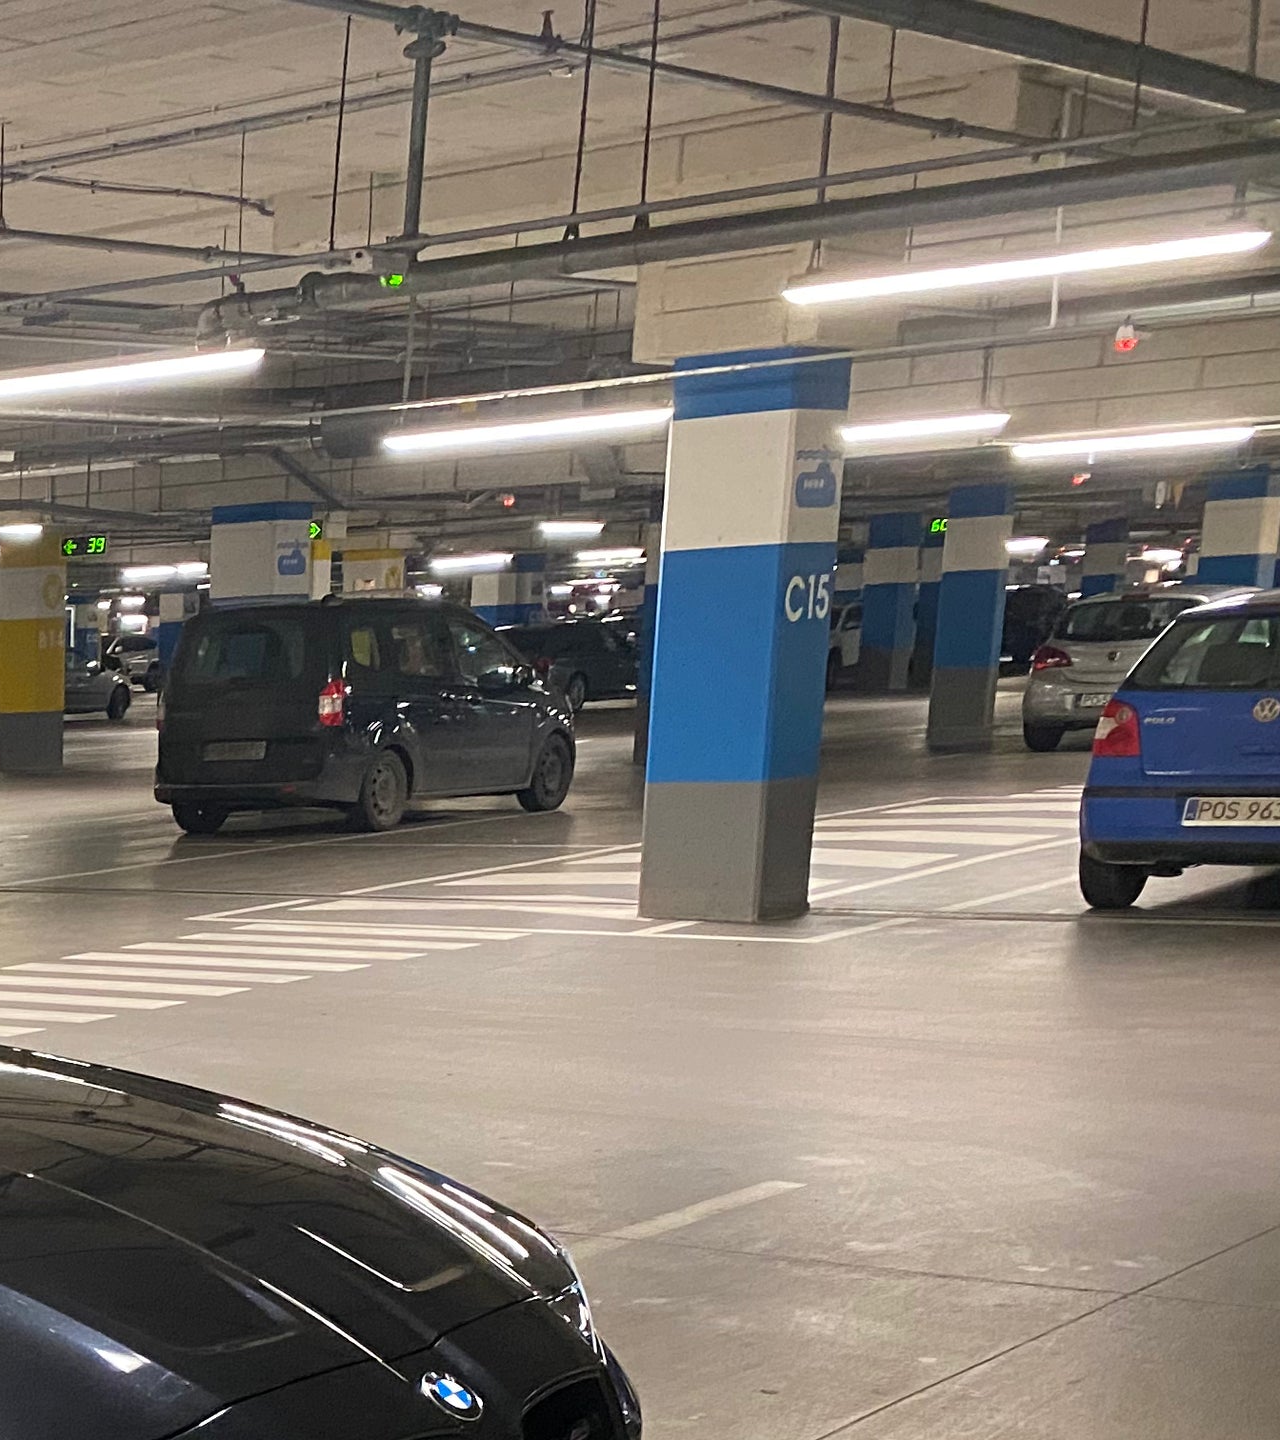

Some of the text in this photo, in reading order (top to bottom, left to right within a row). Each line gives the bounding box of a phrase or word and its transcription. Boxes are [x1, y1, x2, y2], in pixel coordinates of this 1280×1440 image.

[86, 537, 105, 552] 39
[785, 574, 830, 622] C15
[1198, 801, 1241, 820] POS
